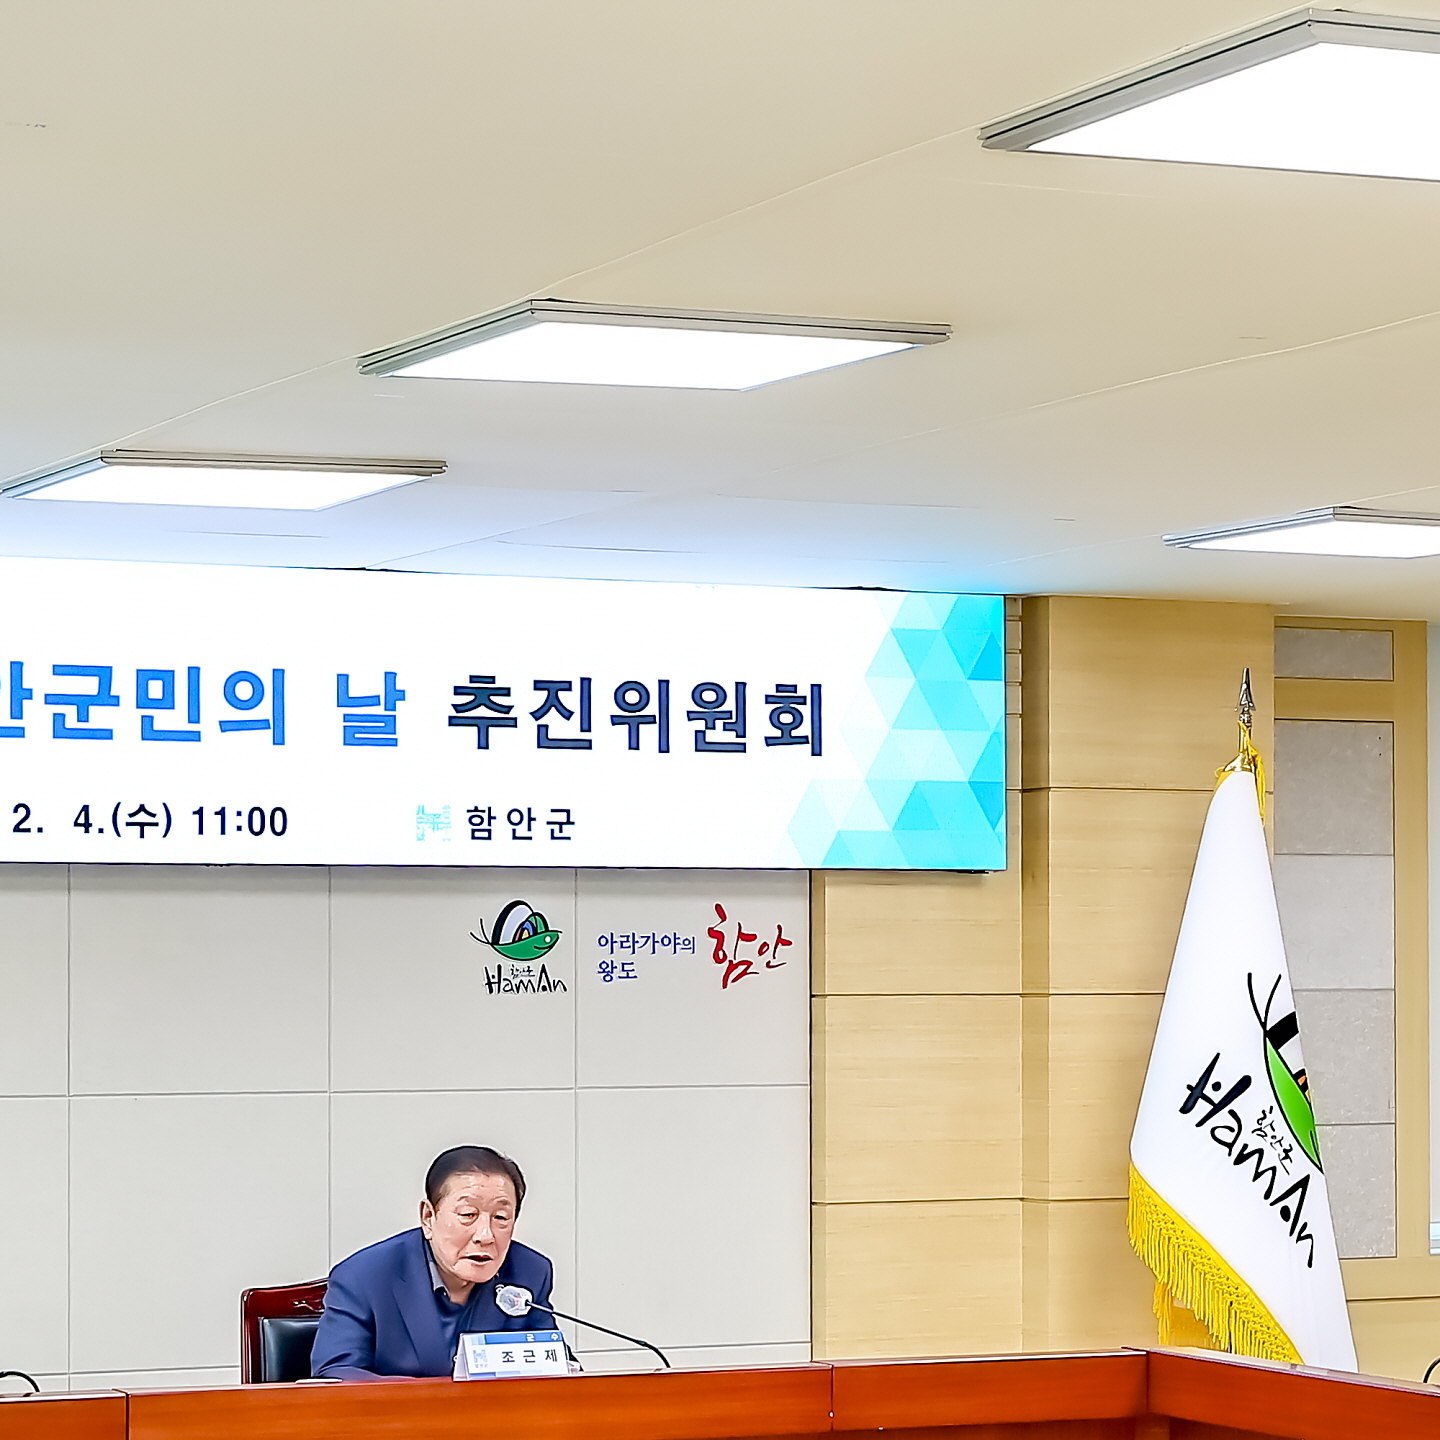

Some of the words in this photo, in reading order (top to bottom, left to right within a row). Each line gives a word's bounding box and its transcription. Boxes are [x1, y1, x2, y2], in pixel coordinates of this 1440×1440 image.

[336, 671, 407, 748] 날
[447, 675, 824, 757] 추진위원회
[11, 802, 45, 834] 2.
[73, 801, 173, 839] 4.(수)
[192, 806, 289, 837] 11:00
[466, 805, 576, 841] 함안군
[597, 931, 696, 955] 아라가야의
[707, 902, 793, 989] 함안
[484, 963, 568, 995] HamAn
[597, 959, 638, 983] 왕도
[1178, 1052, 1314, 1269] HamAn
